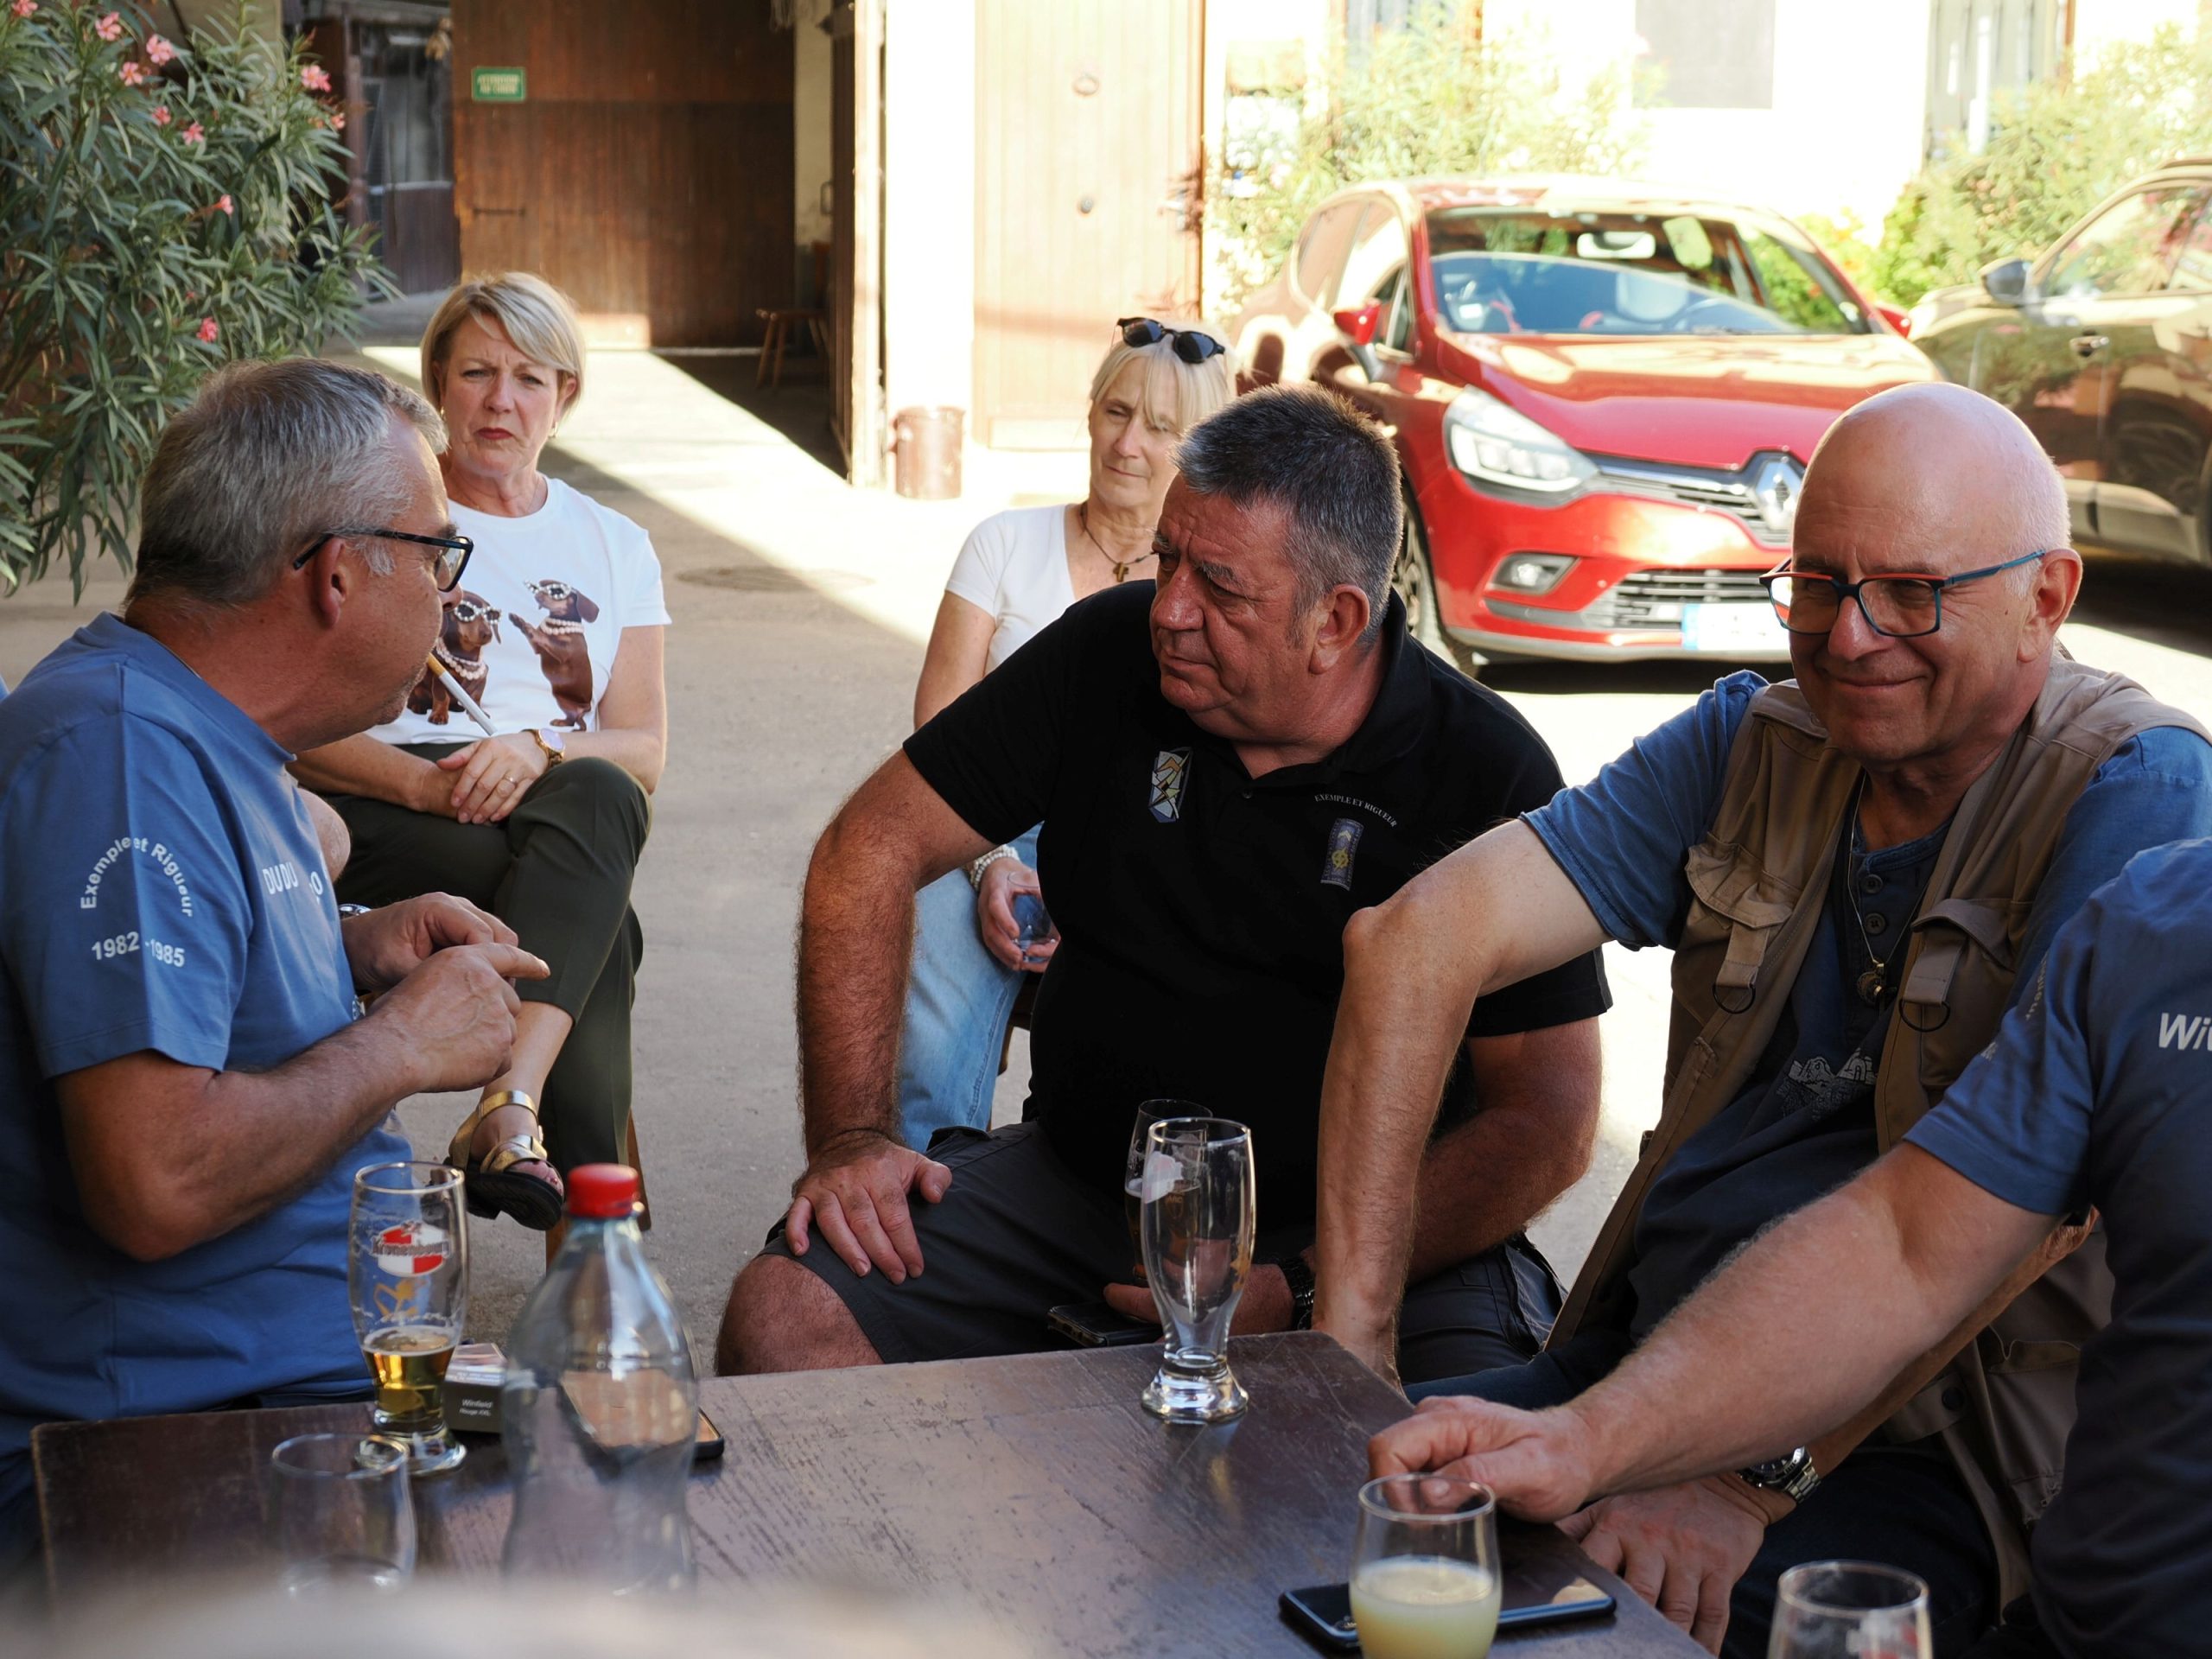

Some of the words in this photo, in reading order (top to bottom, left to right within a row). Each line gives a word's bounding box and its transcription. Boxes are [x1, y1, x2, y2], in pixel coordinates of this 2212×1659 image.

[1314, 794, 1351, 804] EXEMPLE
[1352, 798, 1364, 807] ET
[1364, 802, 1397, 828] RIGUEUR
[80, 836, 131, 910] Exemple
[133, 837, 148, 854] et
[150, 842, 194, 918] Rigueur
[262, 862, 298, 896] DUDU
[92, 931, 141, 961] 1982
[461, 1398, 493, 1409] Winfield
